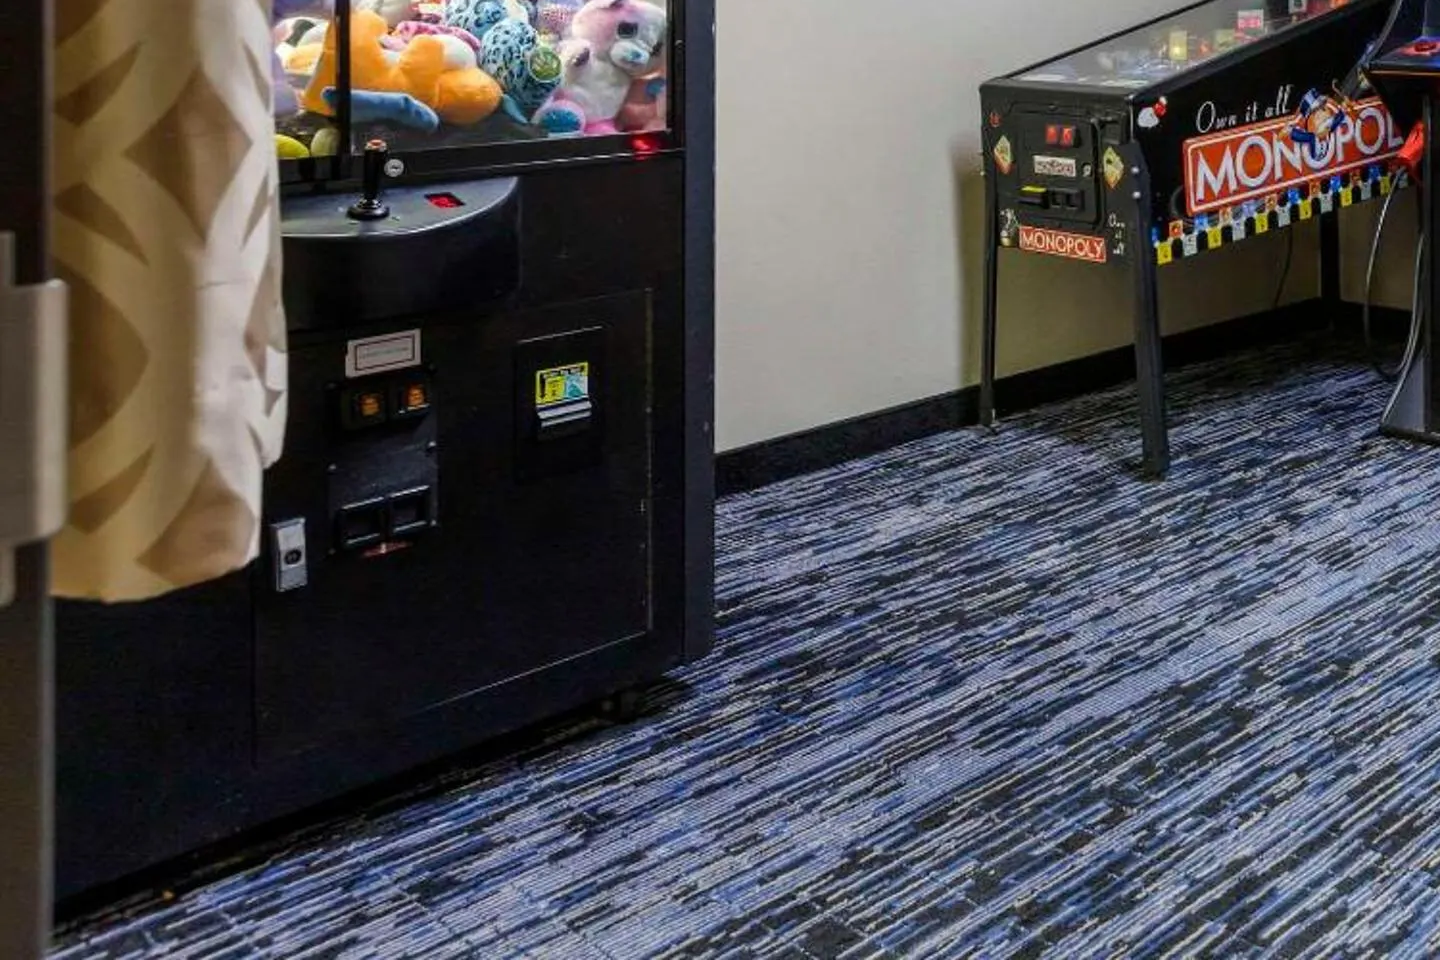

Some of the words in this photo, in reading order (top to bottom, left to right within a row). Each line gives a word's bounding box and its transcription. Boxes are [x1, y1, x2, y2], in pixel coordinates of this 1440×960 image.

[1195, 100, 1238, 134] Own
[1244, 99, 1259, 123] it
[1264, 83, 1295, 118] all
[1022, 228, 1105, 259] MONOPOLY
